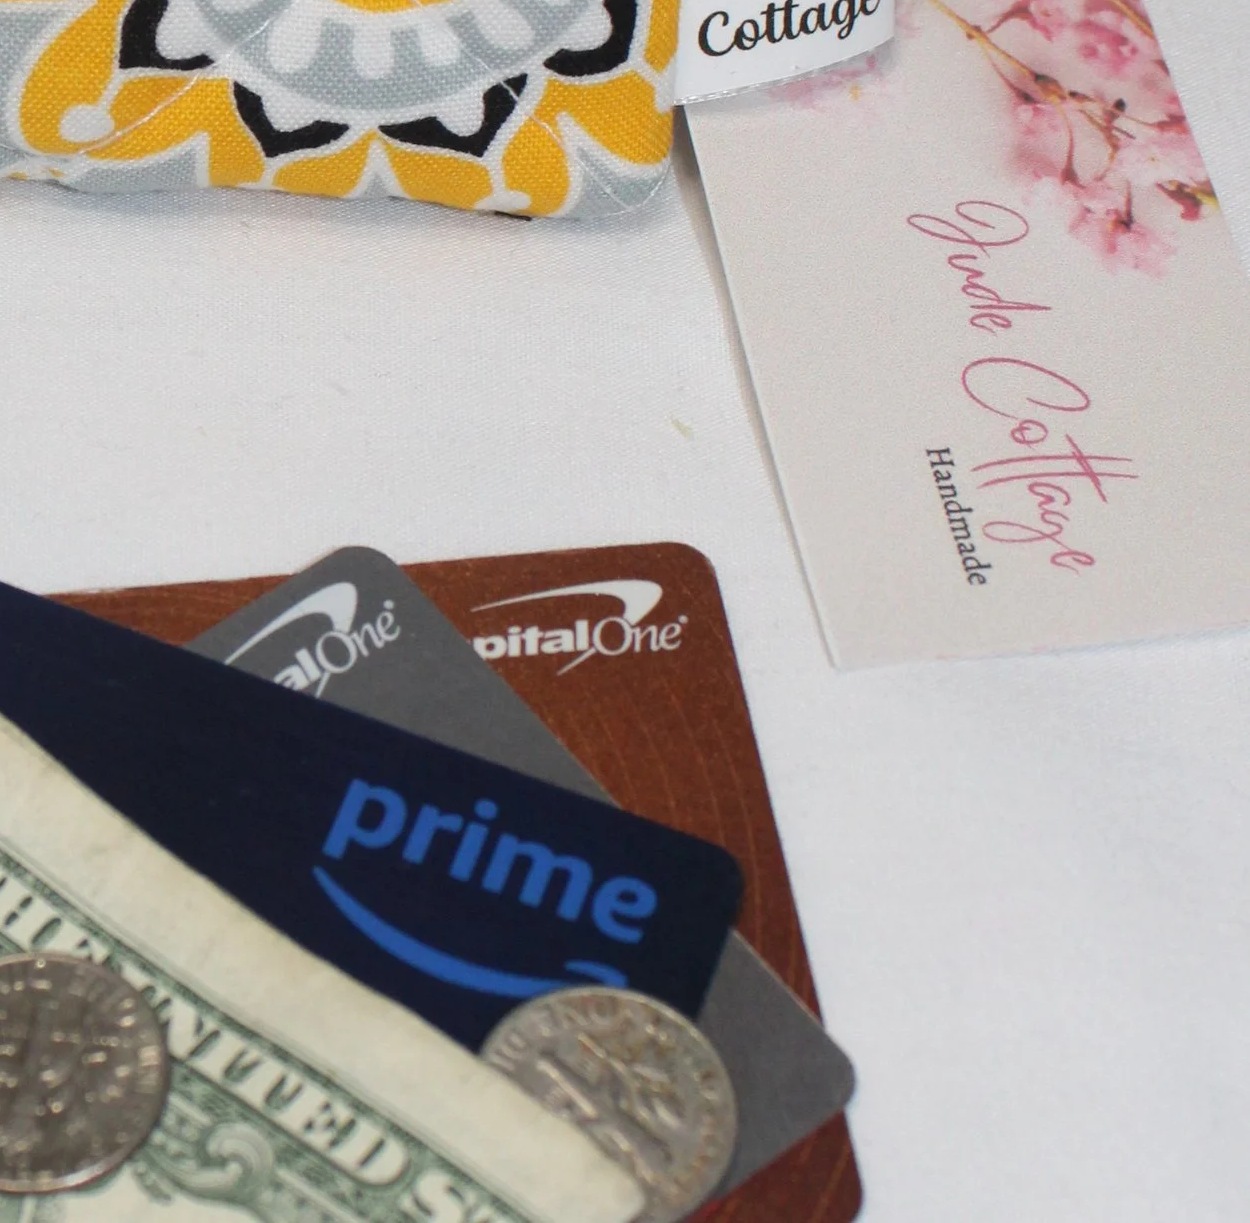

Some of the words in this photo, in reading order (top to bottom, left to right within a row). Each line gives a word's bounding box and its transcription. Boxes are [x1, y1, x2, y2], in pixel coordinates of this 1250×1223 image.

[906, 200, 1053, 336] Jude
[926, 447, 993, 587] Handmade
[961, 356, 1140, 576] Cottage
[274, 609, 401, 693] alOne
[473, 613, 687, 661] pitalOne
[322, 777, 659, 945] prime
